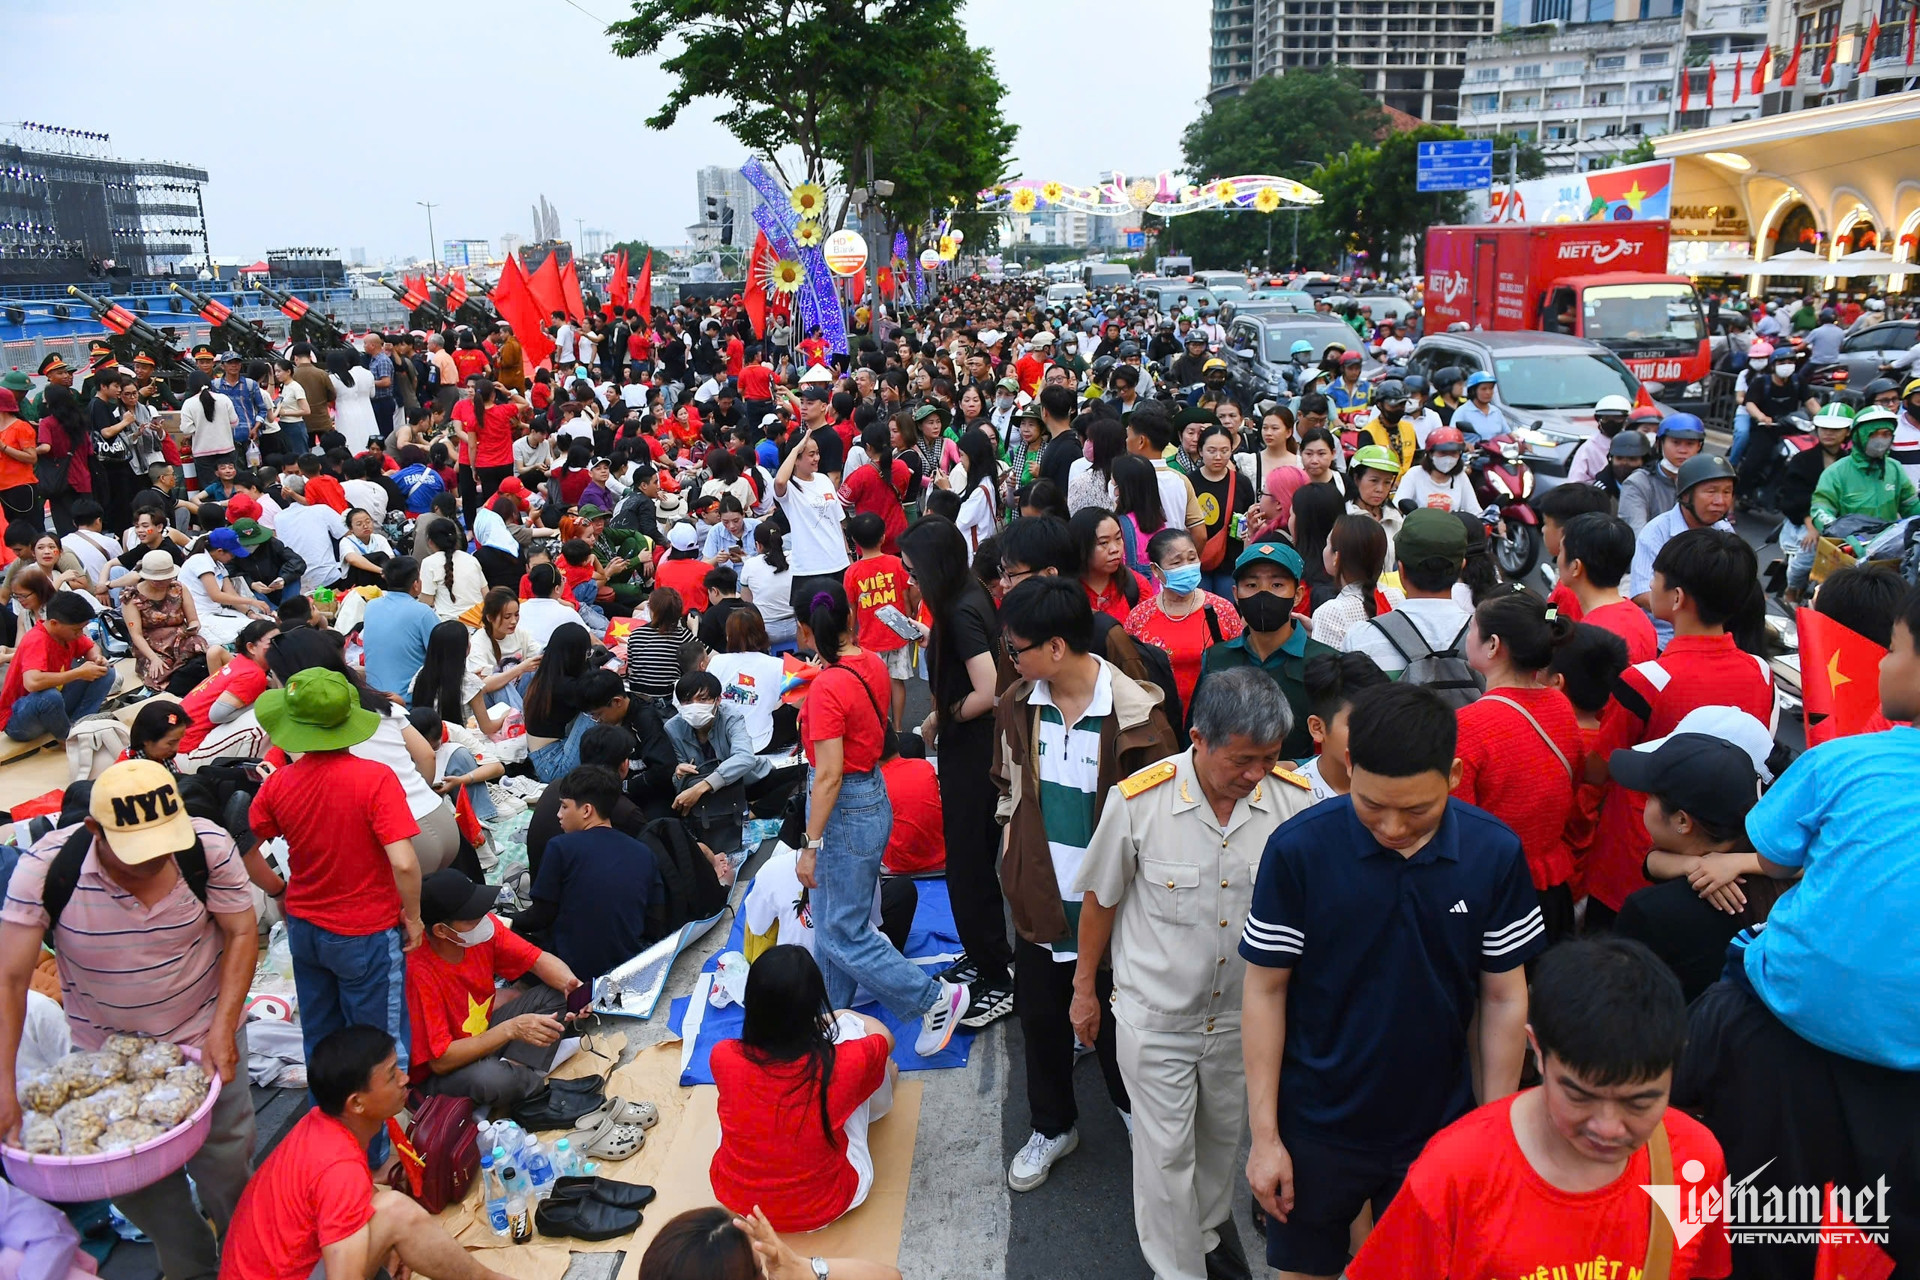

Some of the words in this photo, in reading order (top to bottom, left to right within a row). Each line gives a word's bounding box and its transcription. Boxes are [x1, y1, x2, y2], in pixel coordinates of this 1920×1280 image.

[1633, 351, 1666, 359] ISUZU
[857, 572, 894, 593] VIỆT
[861, 589, 897, 609] NAM
[111, 784, 178, 827] NYC
